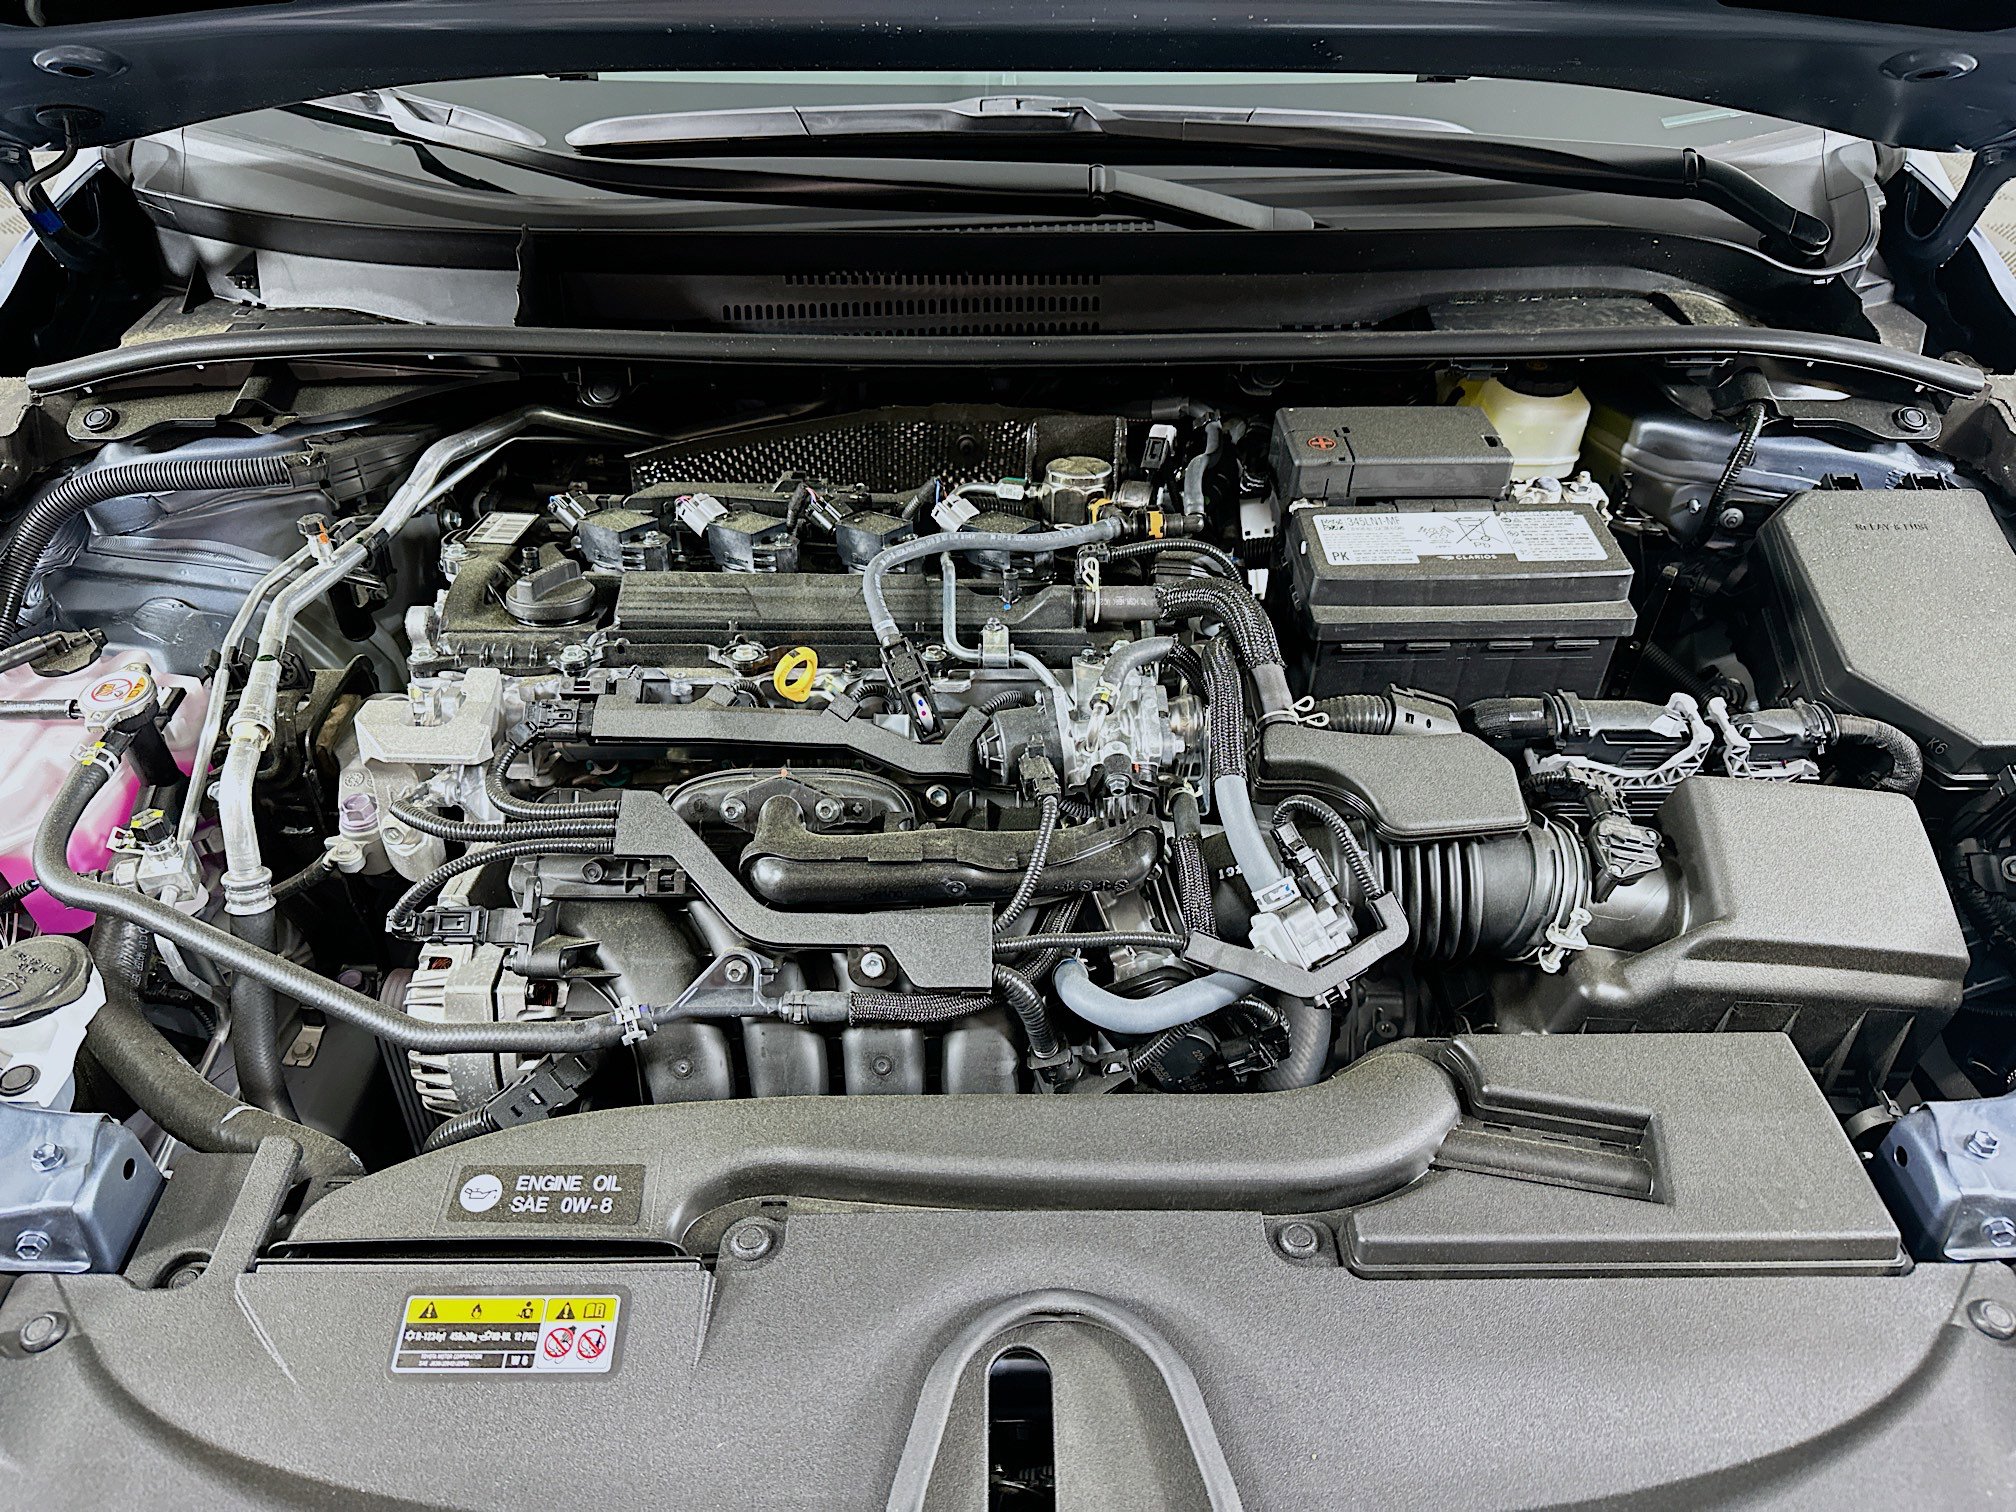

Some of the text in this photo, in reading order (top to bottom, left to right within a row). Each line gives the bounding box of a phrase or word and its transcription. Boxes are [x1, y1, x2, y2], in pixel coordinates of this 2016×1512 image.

[1332, 551, 1350, 561] PK
[1926, 737, 1948, 755] K6
[515, 1174, 622, 1192] ENGINE OIL
[510, 1196, 613, 1214] SAE 0W-8
